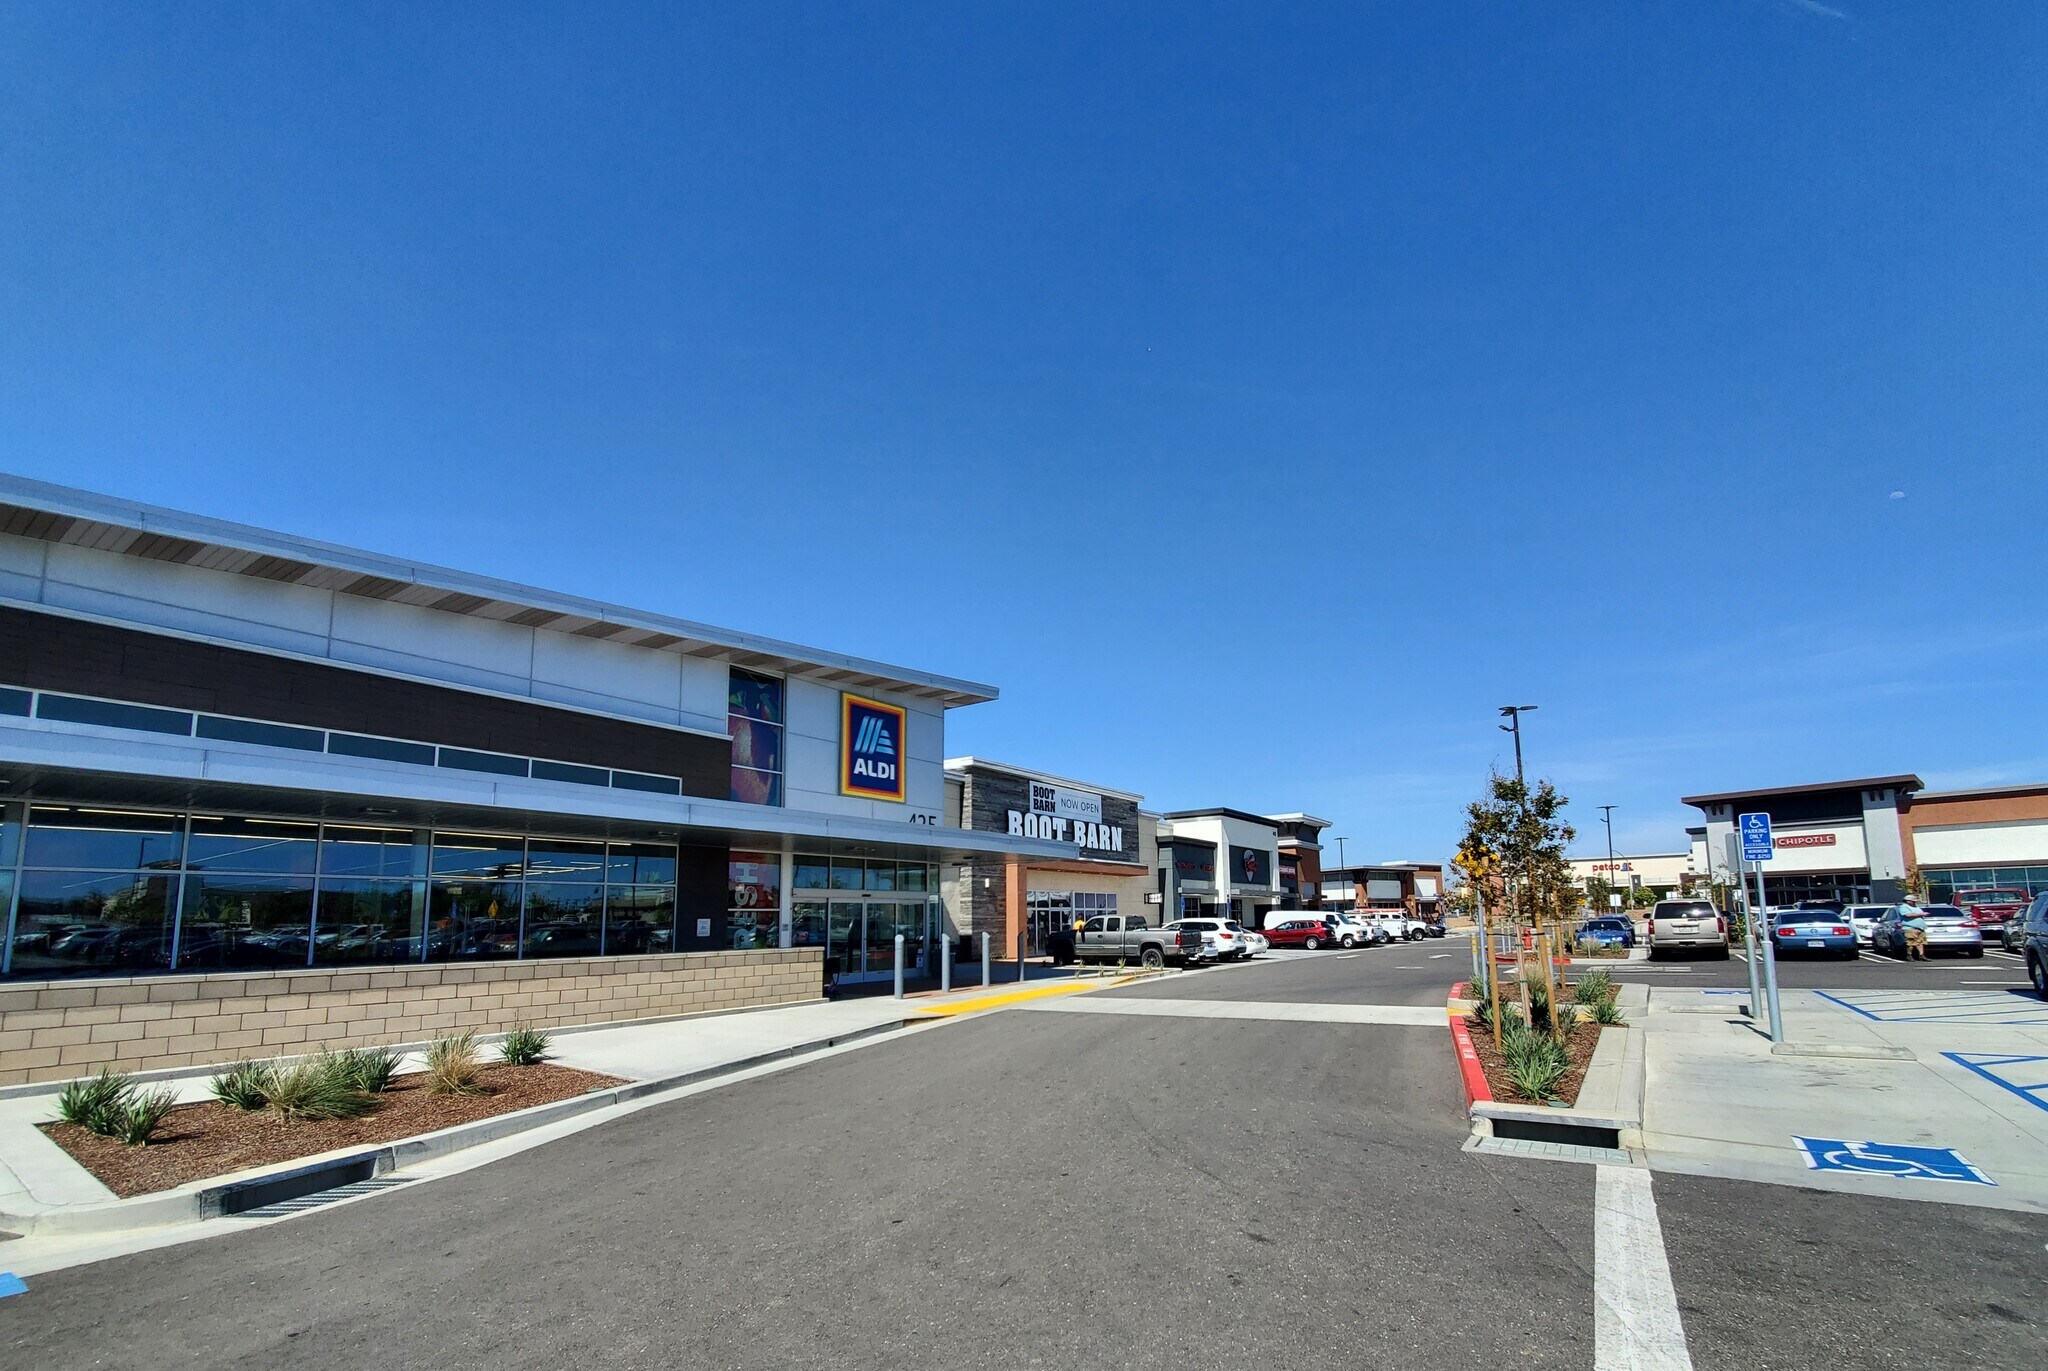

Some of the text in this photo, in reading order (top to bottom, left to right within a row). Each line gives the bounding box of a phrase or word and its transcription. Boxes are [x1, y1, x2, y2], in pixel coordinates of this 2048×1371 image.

[853, 757, 896, 780] ALDI
[1033, 785, 1056, 800] BOOT
[1033, 798, 1056, 813] BARN
[1061, 798, 1099, 813] NOW OPEN
[1008, 809, 1123, 852] BOOT BARN
[1778, 835, 1834, 846] CHIPOTLE
[1592, 863, 1621, 873] petco
